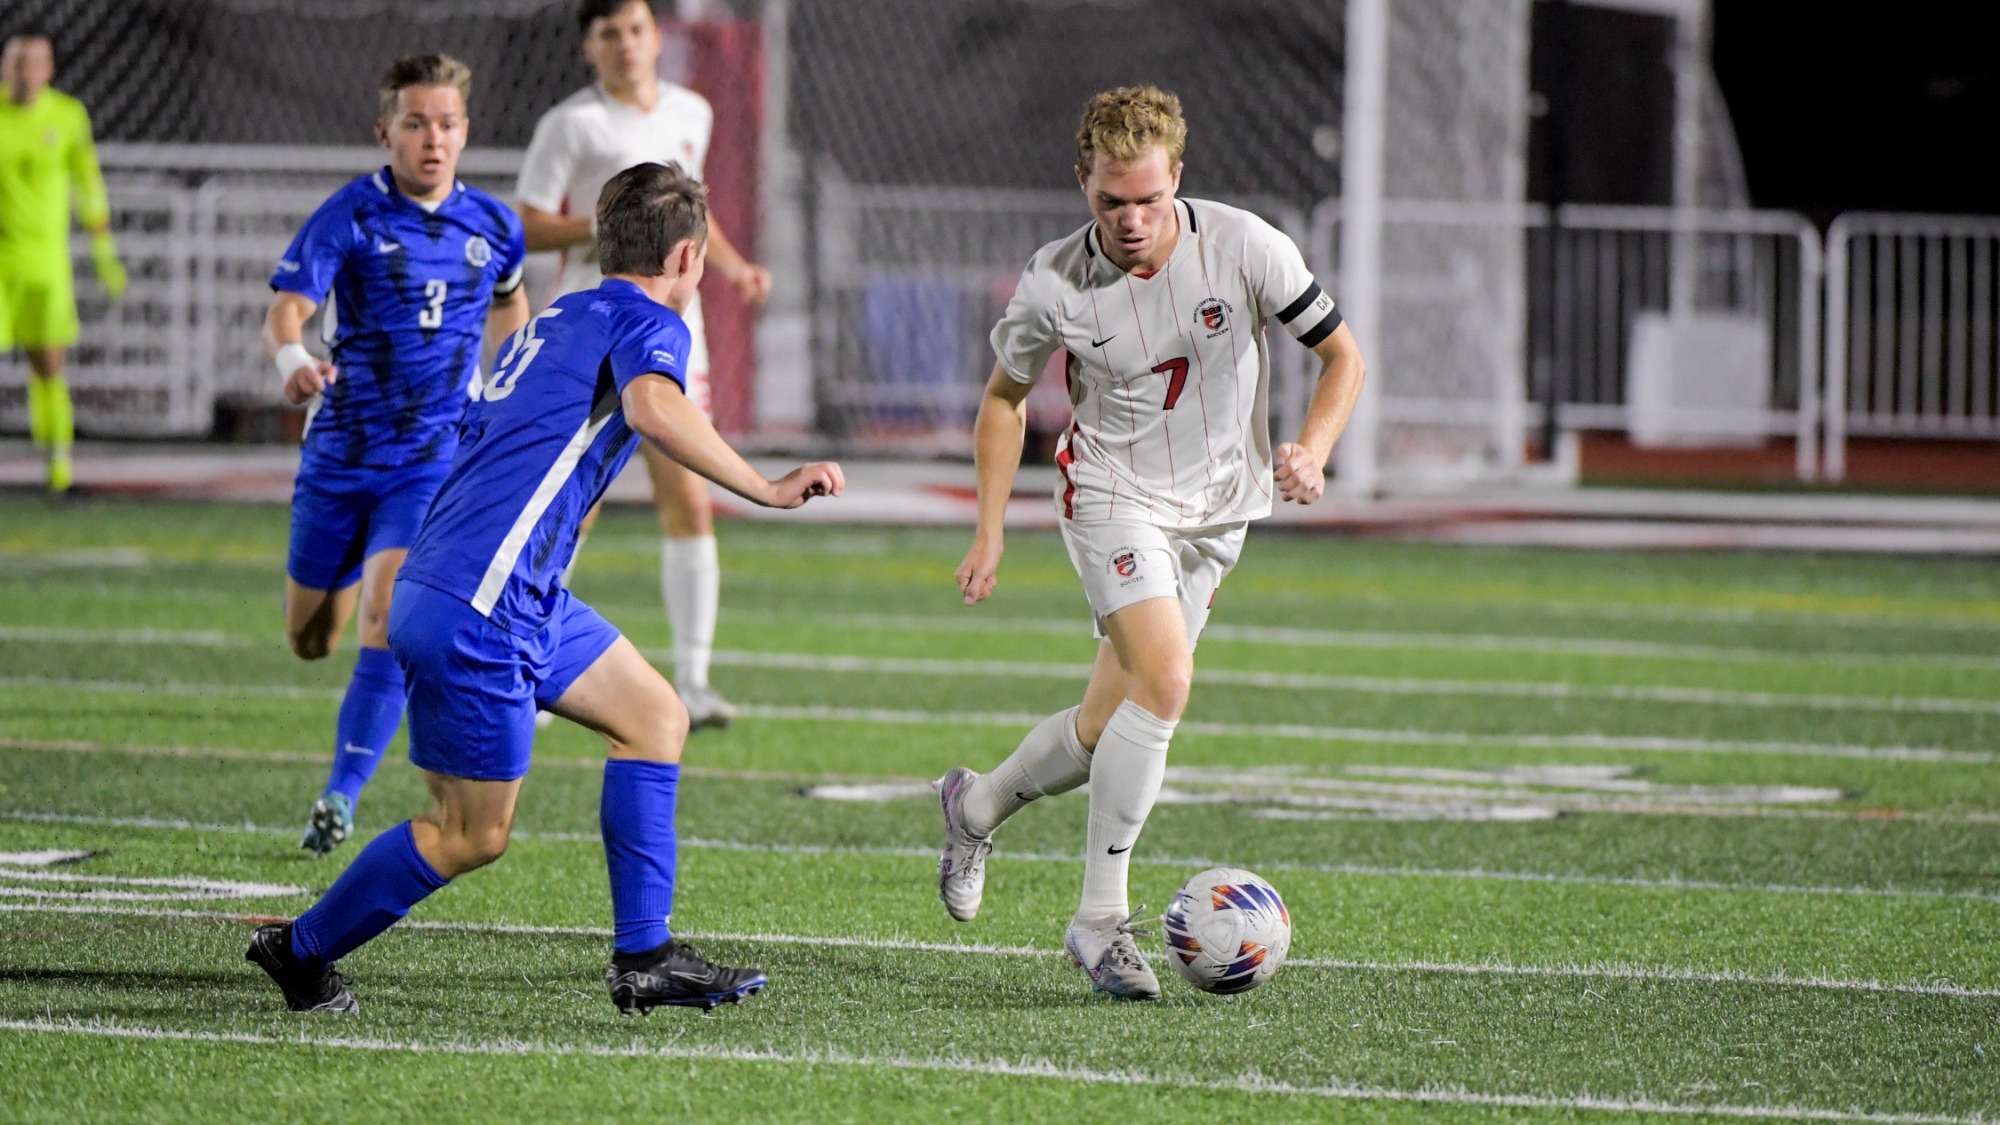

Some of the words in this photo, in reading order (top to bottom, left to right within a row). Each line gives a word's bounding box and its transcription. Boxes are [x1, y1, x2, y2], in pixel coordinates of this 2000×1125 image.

[419, 279, 447, 328] 3
[1206, 327, 1229, 339] SOCCER
[1151, 357, 1190, 410] 7
[1120, 575, 1144, 588] SOCCER
